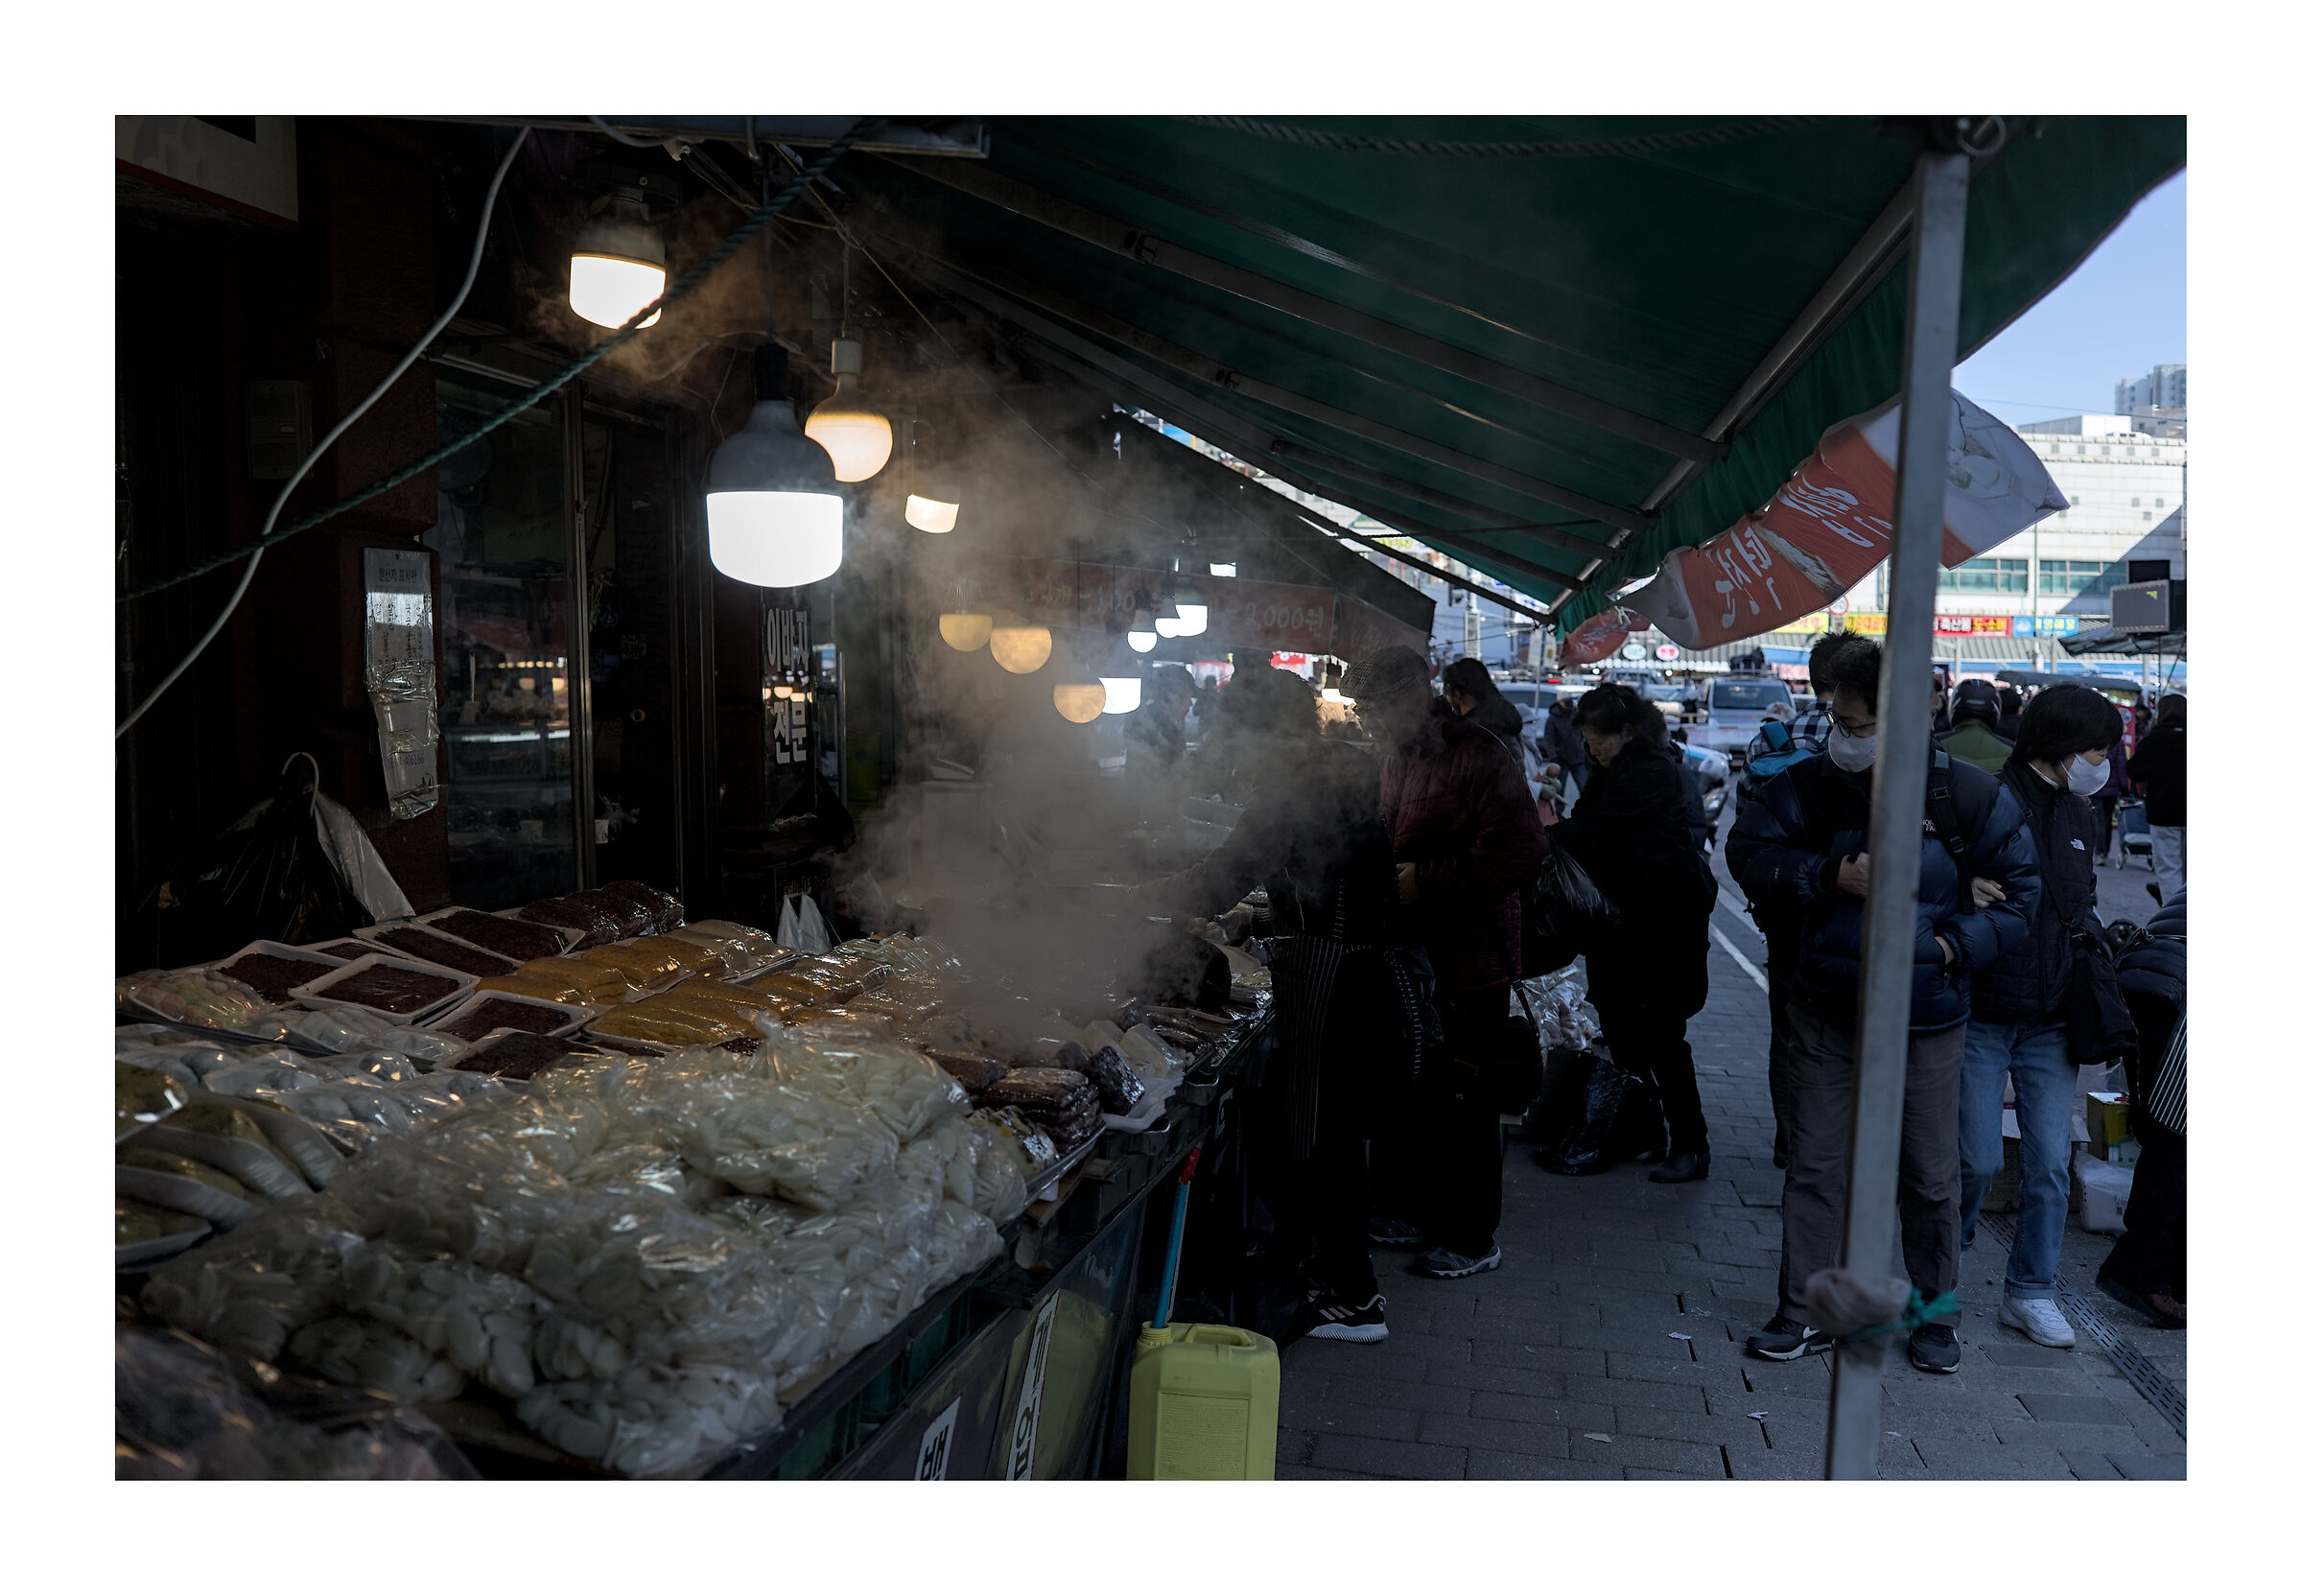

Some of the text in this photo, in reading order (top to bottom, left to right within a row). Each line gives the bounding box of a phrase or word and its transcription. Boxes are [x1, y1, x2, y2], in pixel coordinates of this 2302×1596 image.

[766, 607, 810, 672] 이바지
[1244, 601, 1324, 638] 2,000원
[773, 701, 808, 765] 전문
